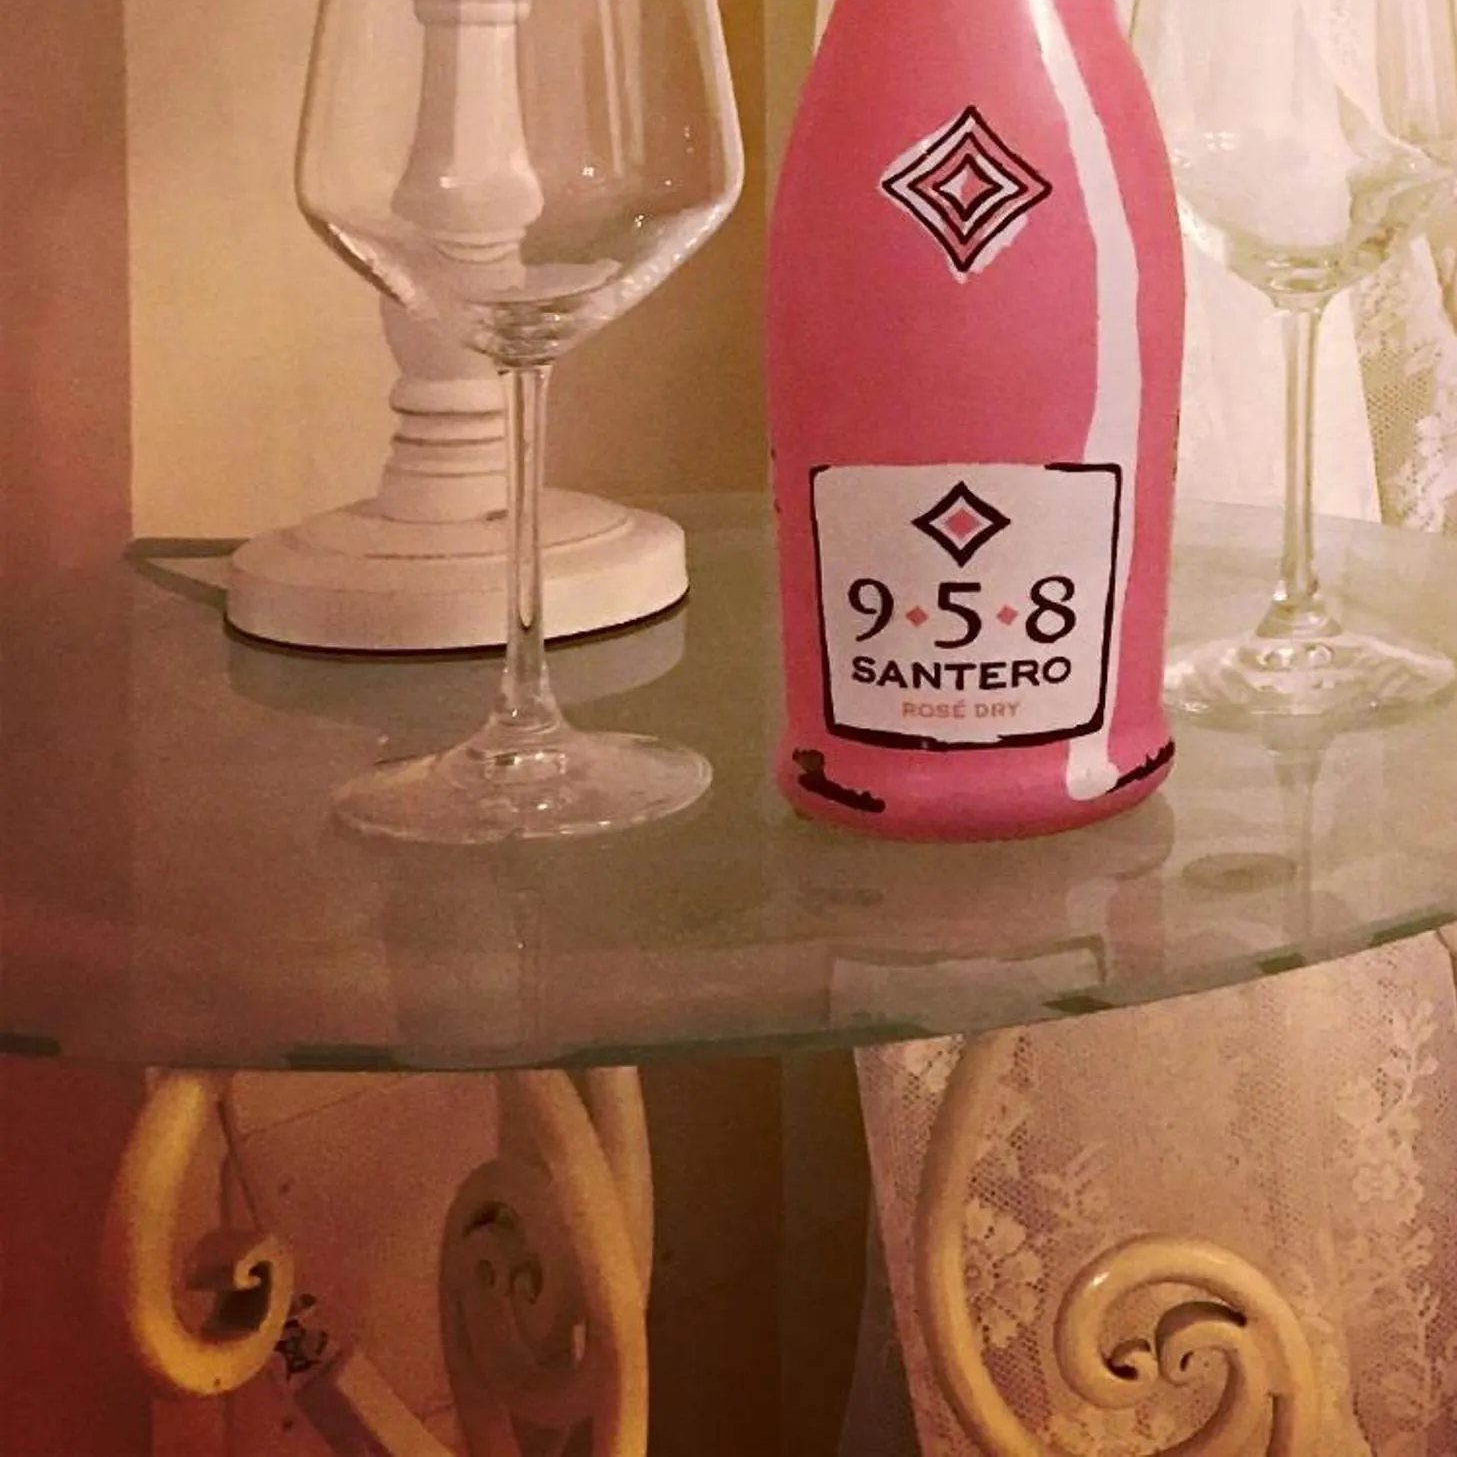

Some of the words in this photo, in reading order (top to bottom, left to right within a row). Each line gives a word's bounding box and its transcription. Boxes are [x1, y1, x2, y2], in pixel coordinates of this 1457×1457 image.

[852, 655, 1072, 691] SANTERO
[902, 699, 966, 719] ROSÉ
[975, 701, 1021, 718] DRY
